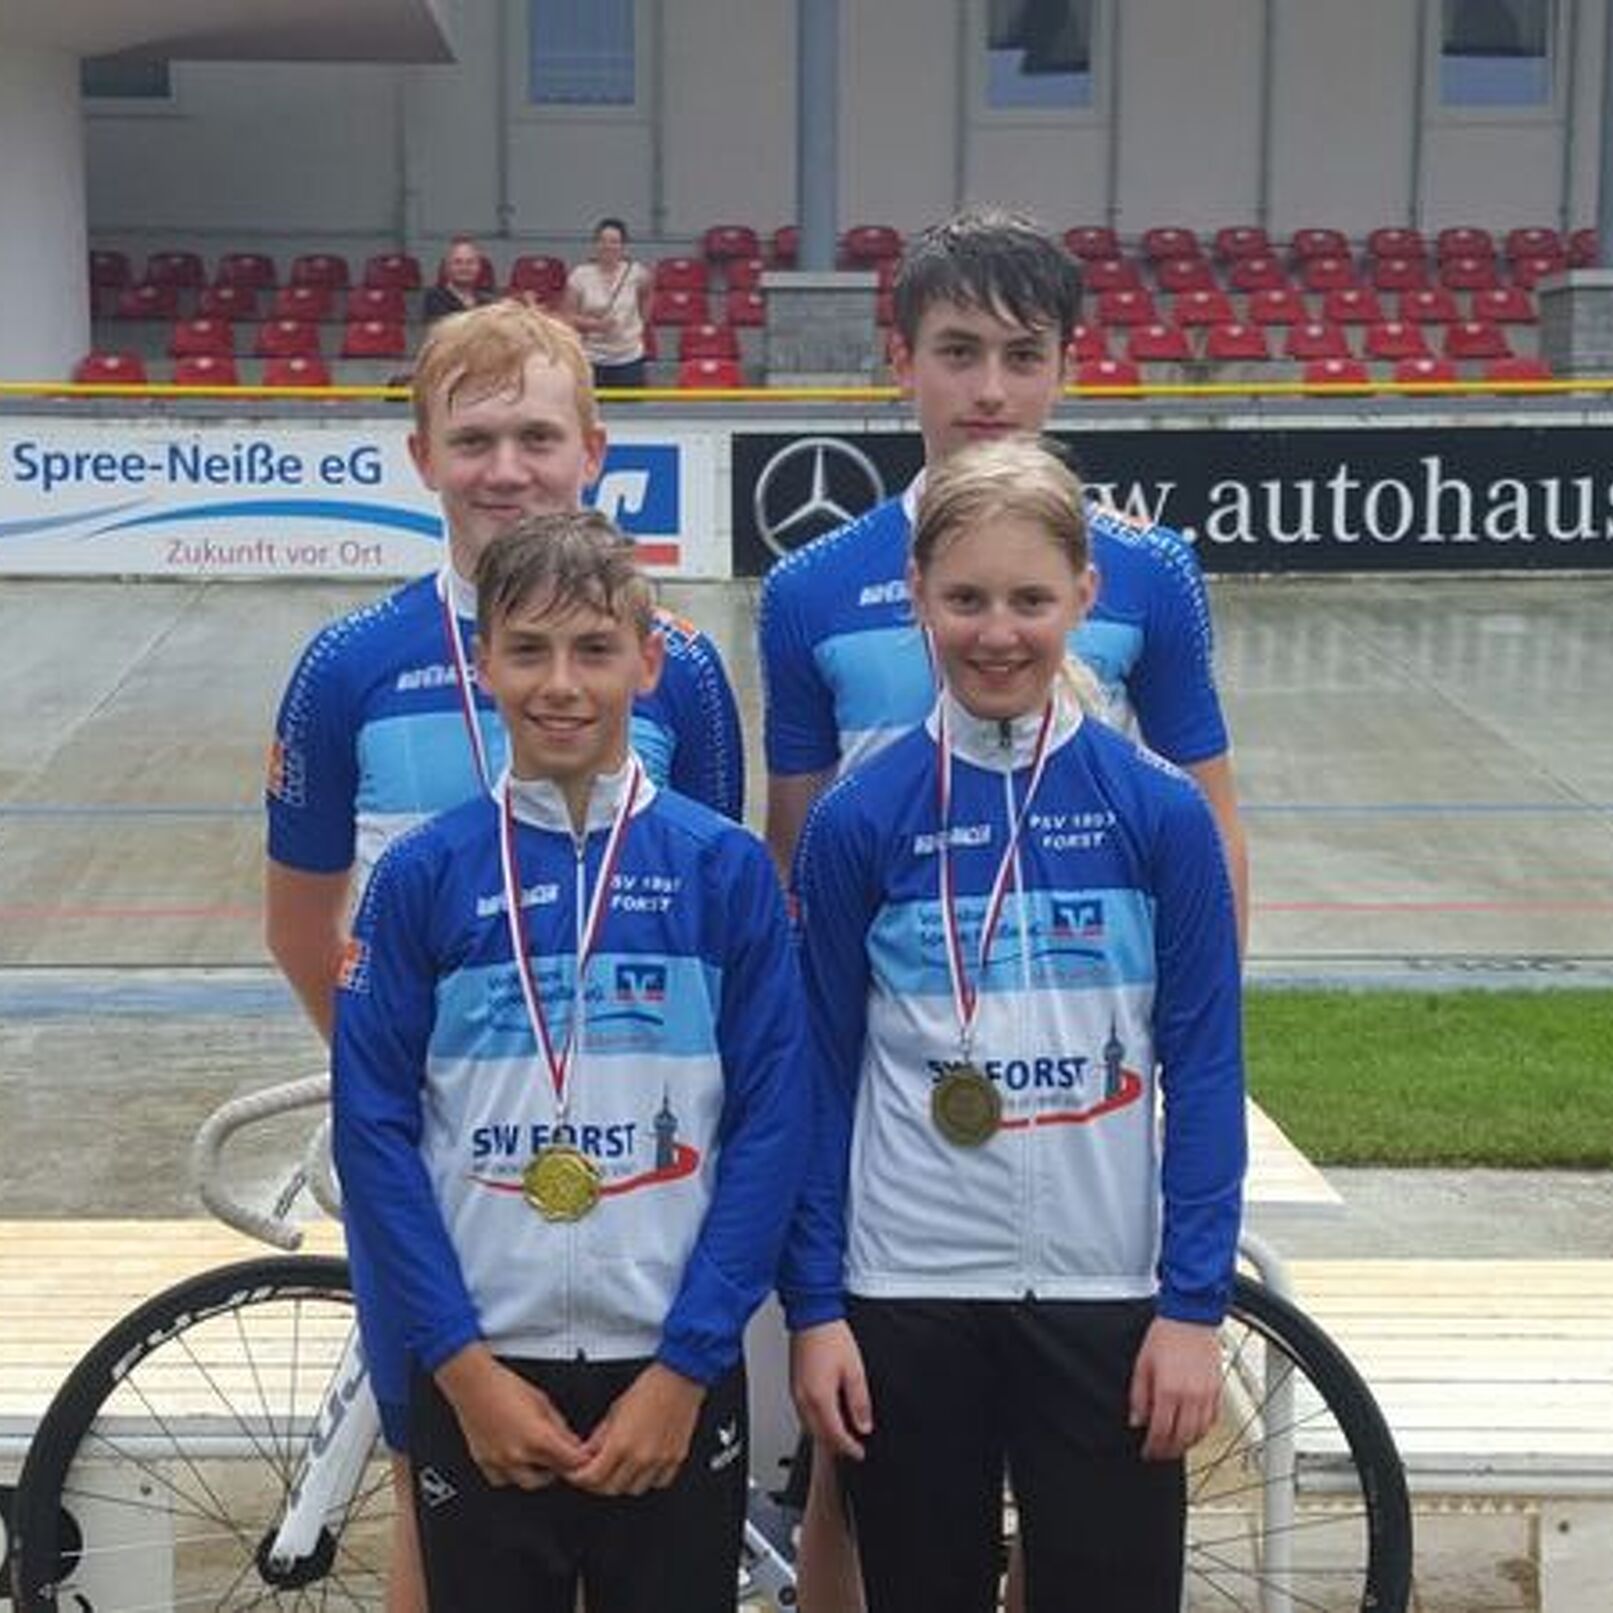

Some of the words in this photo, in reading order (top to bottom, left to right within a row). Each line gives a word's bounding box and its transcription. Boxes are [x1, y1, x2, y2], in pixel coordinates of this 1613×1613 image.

[13, 441, 302, 491] Spree-Neiße
[319, 445, 382, 485] eG
[1080, 455, 1613, 542] w.autohau
[166, 538, 275, 566] Zukunft
[286, 546, 329, 566] vor
[340, 540, 383, 566] Ort
[985, 1057, 1089, 1091] FORST
[472, 1124, 519, 1158] SW
[530, 1122, 637, 1158] FORST
